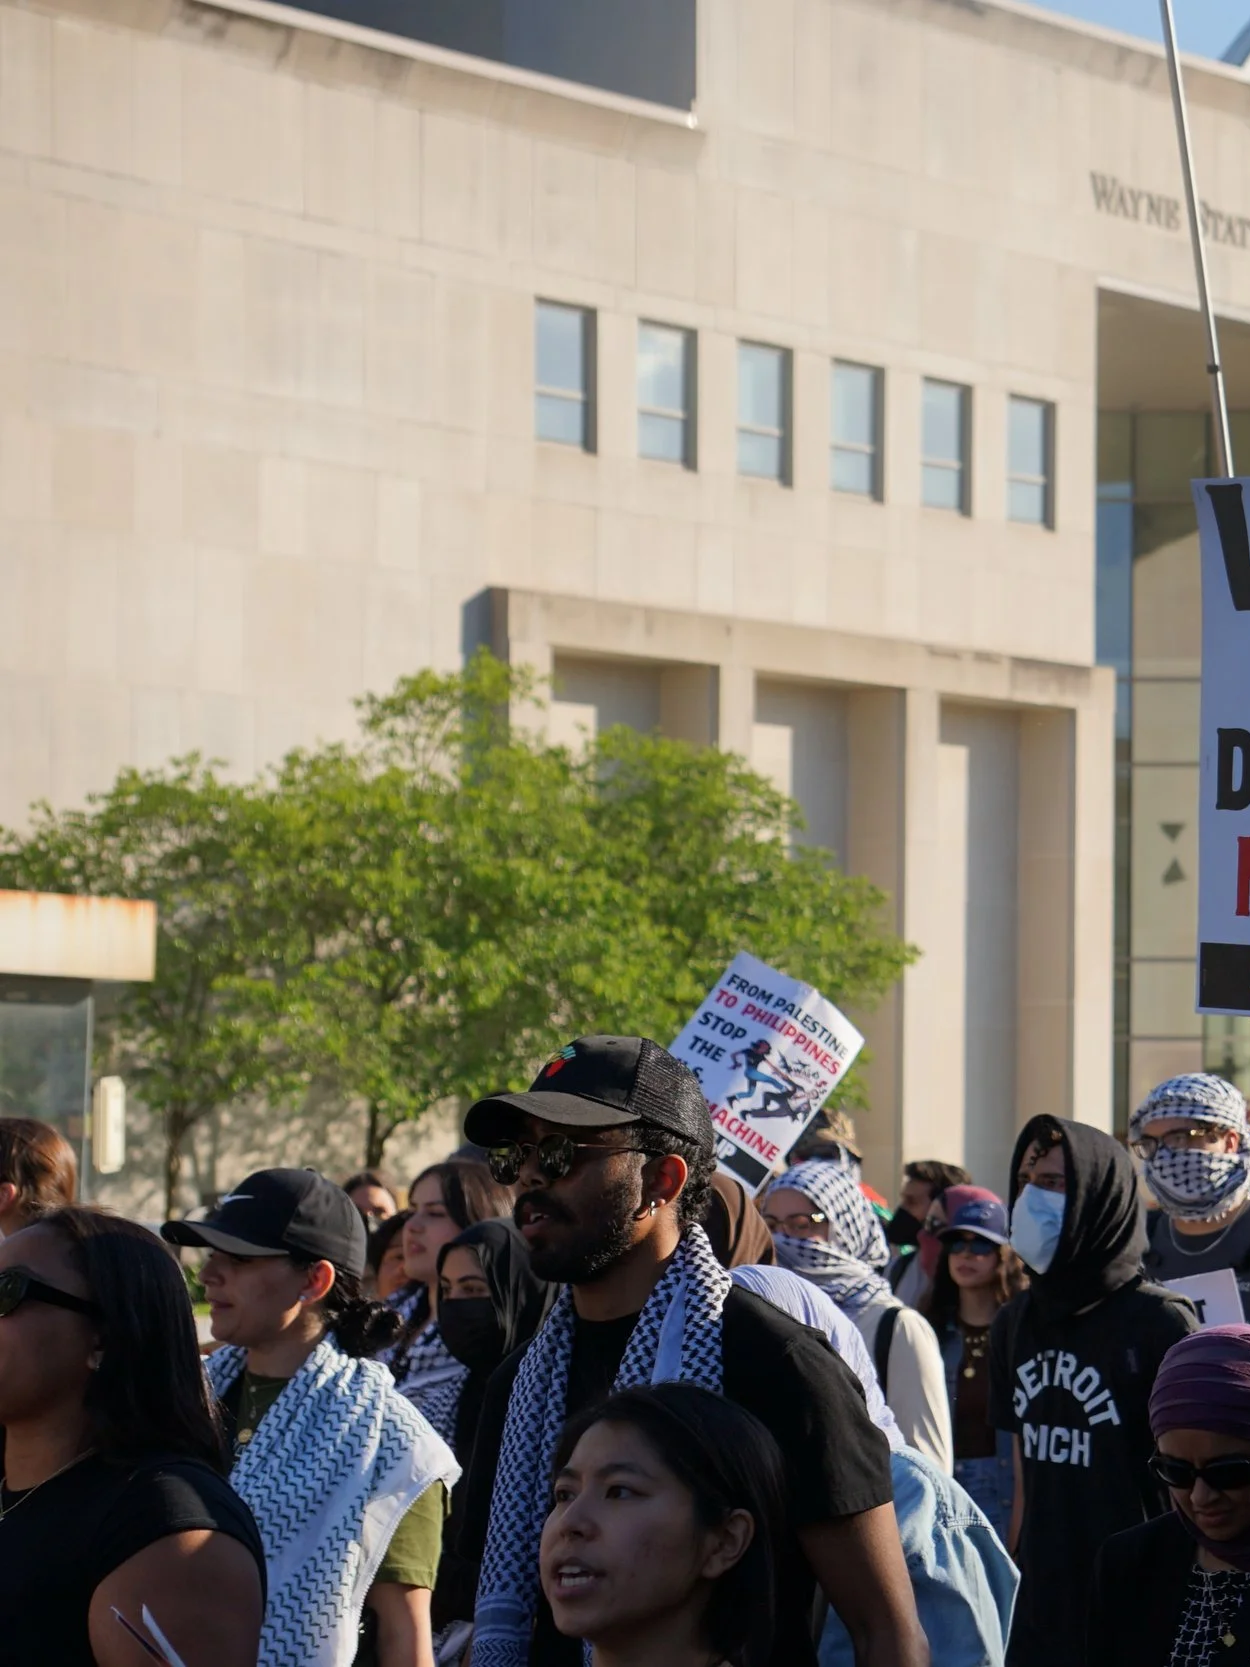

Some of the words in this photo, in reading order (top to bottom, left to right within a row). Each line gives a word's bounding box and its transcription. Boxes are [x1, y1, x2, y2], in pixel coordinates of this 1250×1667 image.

[698, 1011, 747, 1042] STOP
[714, 988, 739, 1010] TO
[741, 1003, 841, 1076] PHILIPPINES
[725, 973, 775, 1008] FROM
[772, 996, 848, 1060] PALESTINE
[688, 1035, 726, 1063] THE
